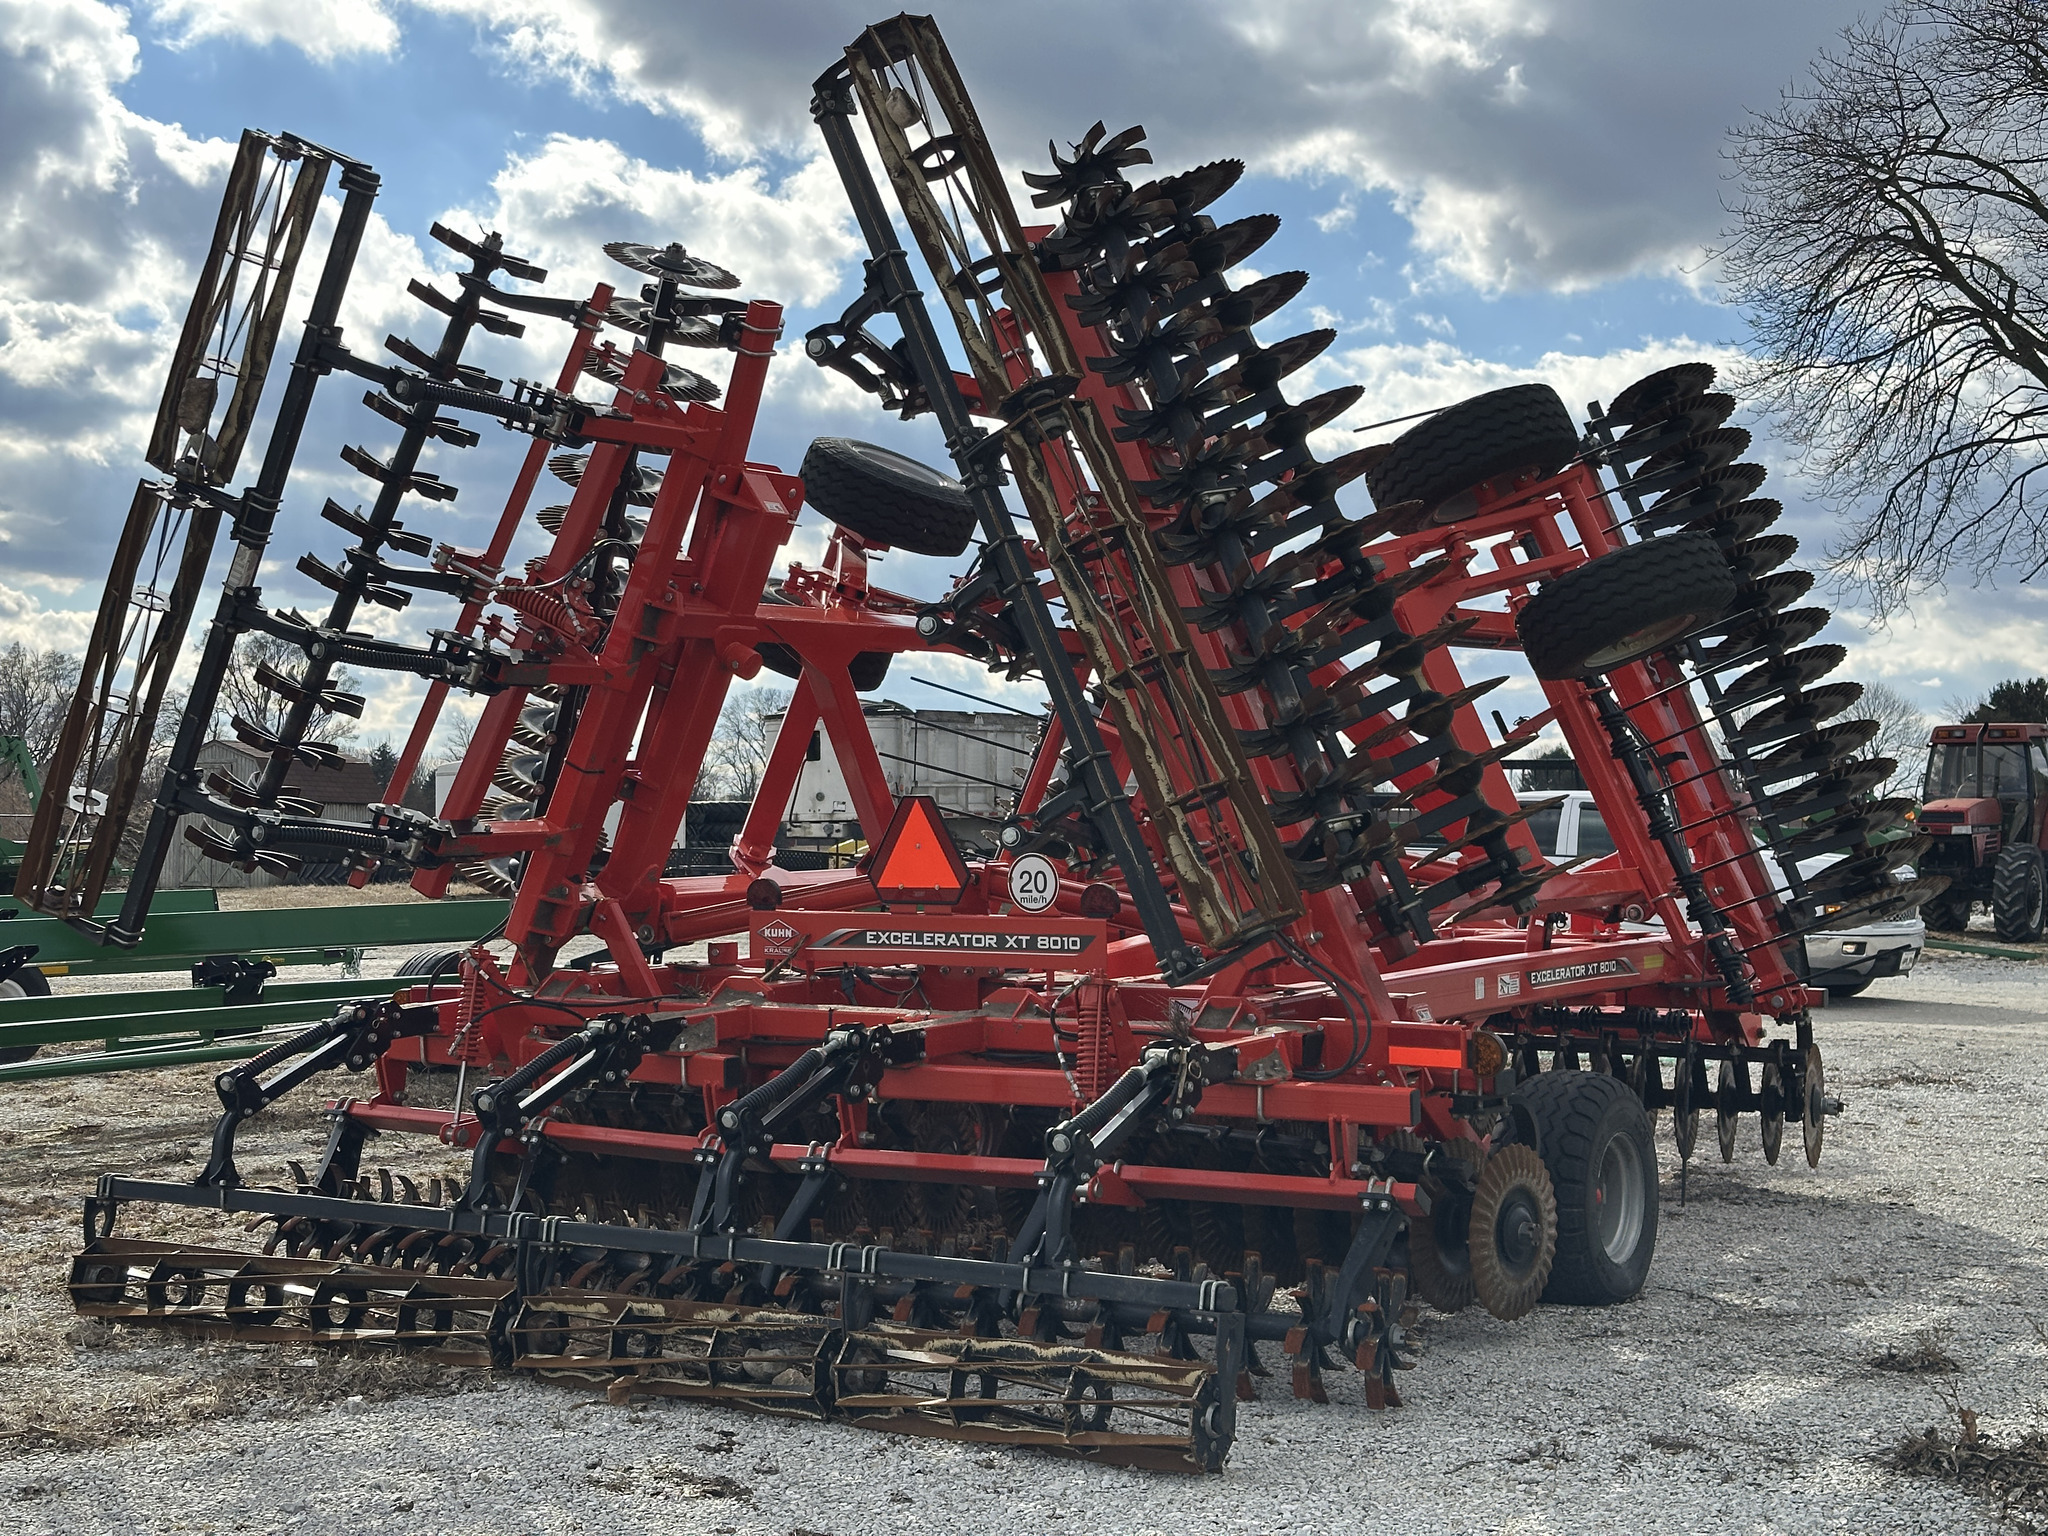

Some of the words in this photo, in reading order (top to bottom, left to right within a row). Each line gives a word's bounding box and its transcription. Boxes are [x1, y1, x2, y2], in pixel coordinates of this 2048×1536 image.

[1019, 870, 1048, 894] 20
[1020, 895, 1047, 904] mile/h
[764, 928, 792, 938] KUHN
[866, 931, 998, 948] EXCELERATOR
[1004, 935, 1031, 949] XT
[1036, 936, 1081, 950] 8010
[1531, 965, 1586, 984] EXCELERATOR
[1588, 963, 1598, 975] XT
[1600, 960, 1617, 973] 8010
